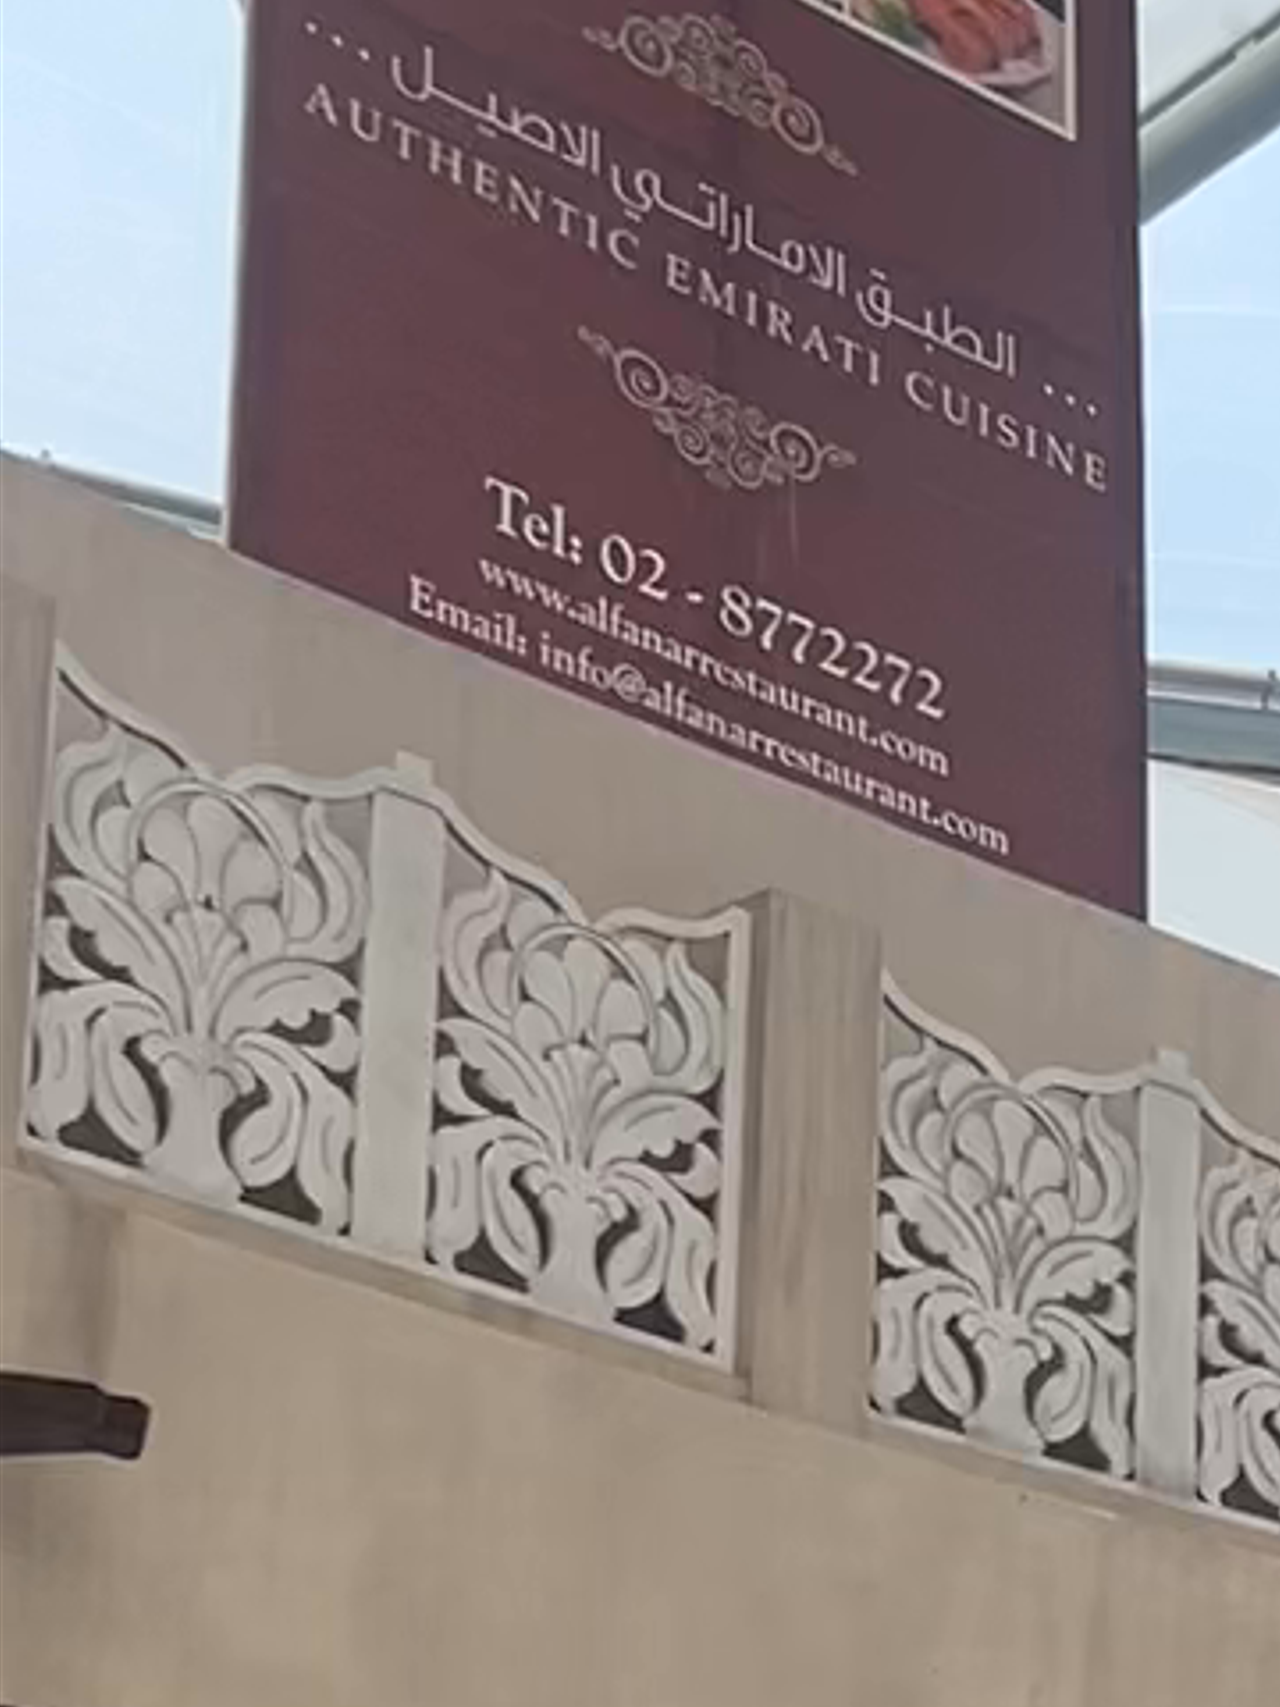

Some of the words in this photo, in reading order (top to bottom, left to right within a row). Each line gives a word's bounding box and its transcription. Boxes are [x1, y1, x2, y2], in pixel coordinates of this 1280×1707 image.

[305, 82, 640, 270] AUTHENTIC
[665, 252, 881, 387] EMIRATI
[904, 370, 1107, 492] CUISINE
[409, 573, 527, 666] Email:
[540, 630, 1010, 856] info@alfanarrestaurant.com
[478, 557, 950, 778] www.alfanarrestaurant.com
[484, 475, 583, 565] Tel:
[600, 533, 669, 601] 02
[718, 584, 948, 720] 8772272
